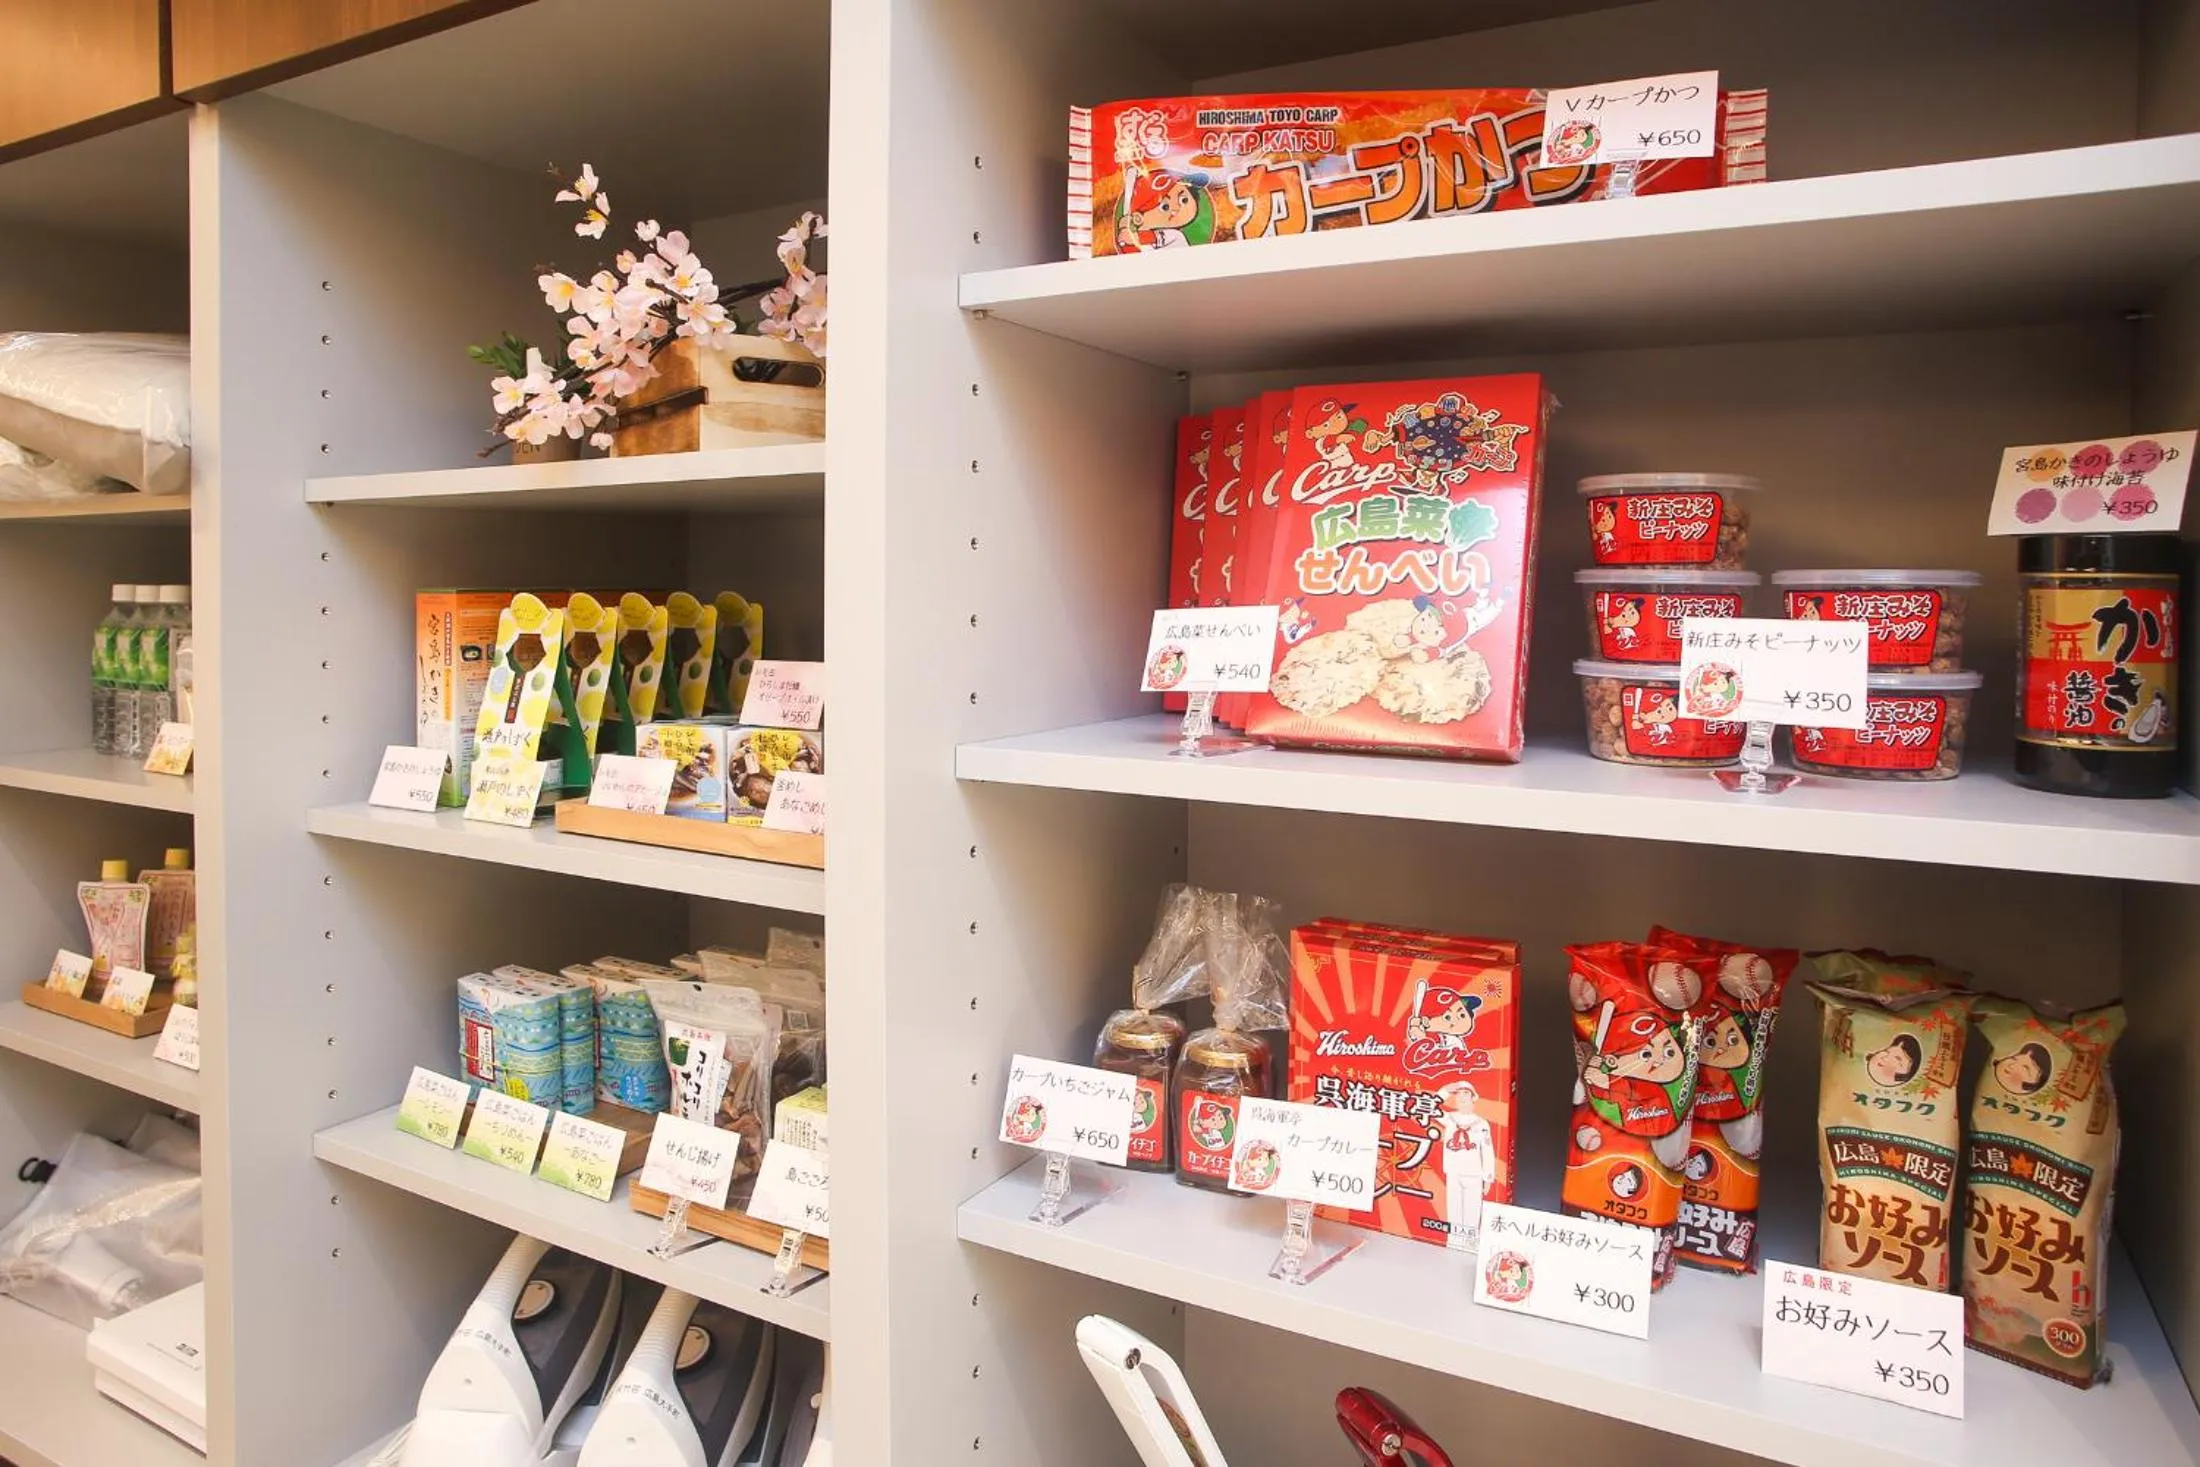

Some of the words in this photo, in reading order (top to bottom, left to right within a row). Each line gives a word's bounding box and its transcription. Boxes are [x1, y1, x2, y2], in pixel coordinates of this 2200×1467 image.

[1198, 110, 1265, 126] HIROSHIMA
[1269, 109, 1301, 123] TOYO
[1306, 108, 1338, 122] CARP
[1203, 131, 1259, 156] CARP
[1262, 129, 1336, 153] KATSU
[1638, 129, 1702, 146] ¥650
[2015, 447, 2180, 474] 宮島かきのしょうゆ
[2052, 471, 2146, 488] 味付け海苔
[1627, 497, 1713, 520] 新庄みそ
[2102, 499, 2159, 515] ¥350
[1313, 493, 1450, 549] 広島菜
[1639, 520, 1709, 541] ピーナッツ
[1296, 547, 1492, 597] せんべい
[1655, 596, 1737, 619] 新庄みそ
[1835, 595, 1932, 618] 新庄みそ
[1165, 623, 1262, 641] 広島菜せんべい
[1862, 618, 1926, 641] ーナッツ
[1214, 662, 1261, 681] ¥540
[1783, 690, 1852, 713] ¥350
[1864, 699, 1937, 722] 庄みそ
[1316, 1030, 1396, 1057] Hiroshima
[1402, 1037, 1492, 1080] Carp
[1314, 1074, 1445, 1127] 呉海軍亭
[1853, 1091, 1936, 1116] オタフク
[1981, 1096, 2066, 1128] オタフク
[1073, 1129, 1120, 1150] ¥650
[1833, 1140, 1880, 1165] 広島
[1904, 1152, 1952, 1187] 限定
[1312, 1169, 1364, 1194] ¥500
[2033, 1161, 2084, 1202] 限定
[1827, 1183, 1949, 1250] お好み
[1964, 1189, 2086, 1267] お好み
[1490, 1215, 1645, 1260] 赤ヘルお好みソース
[1843, 1230, 1928, 1287] ソース
[1975, 1237, 2061, 1304] ソース
[1783, 1269, 1853, 1296] 広島限定
[1573, 1282, 1635, 1314] ¥300
[1776, 1295, 1953, 1358] お好みソース
[2050, 1326, 2079, 1345] 300
[1873, 1360, 1951, 1397] ¥350
